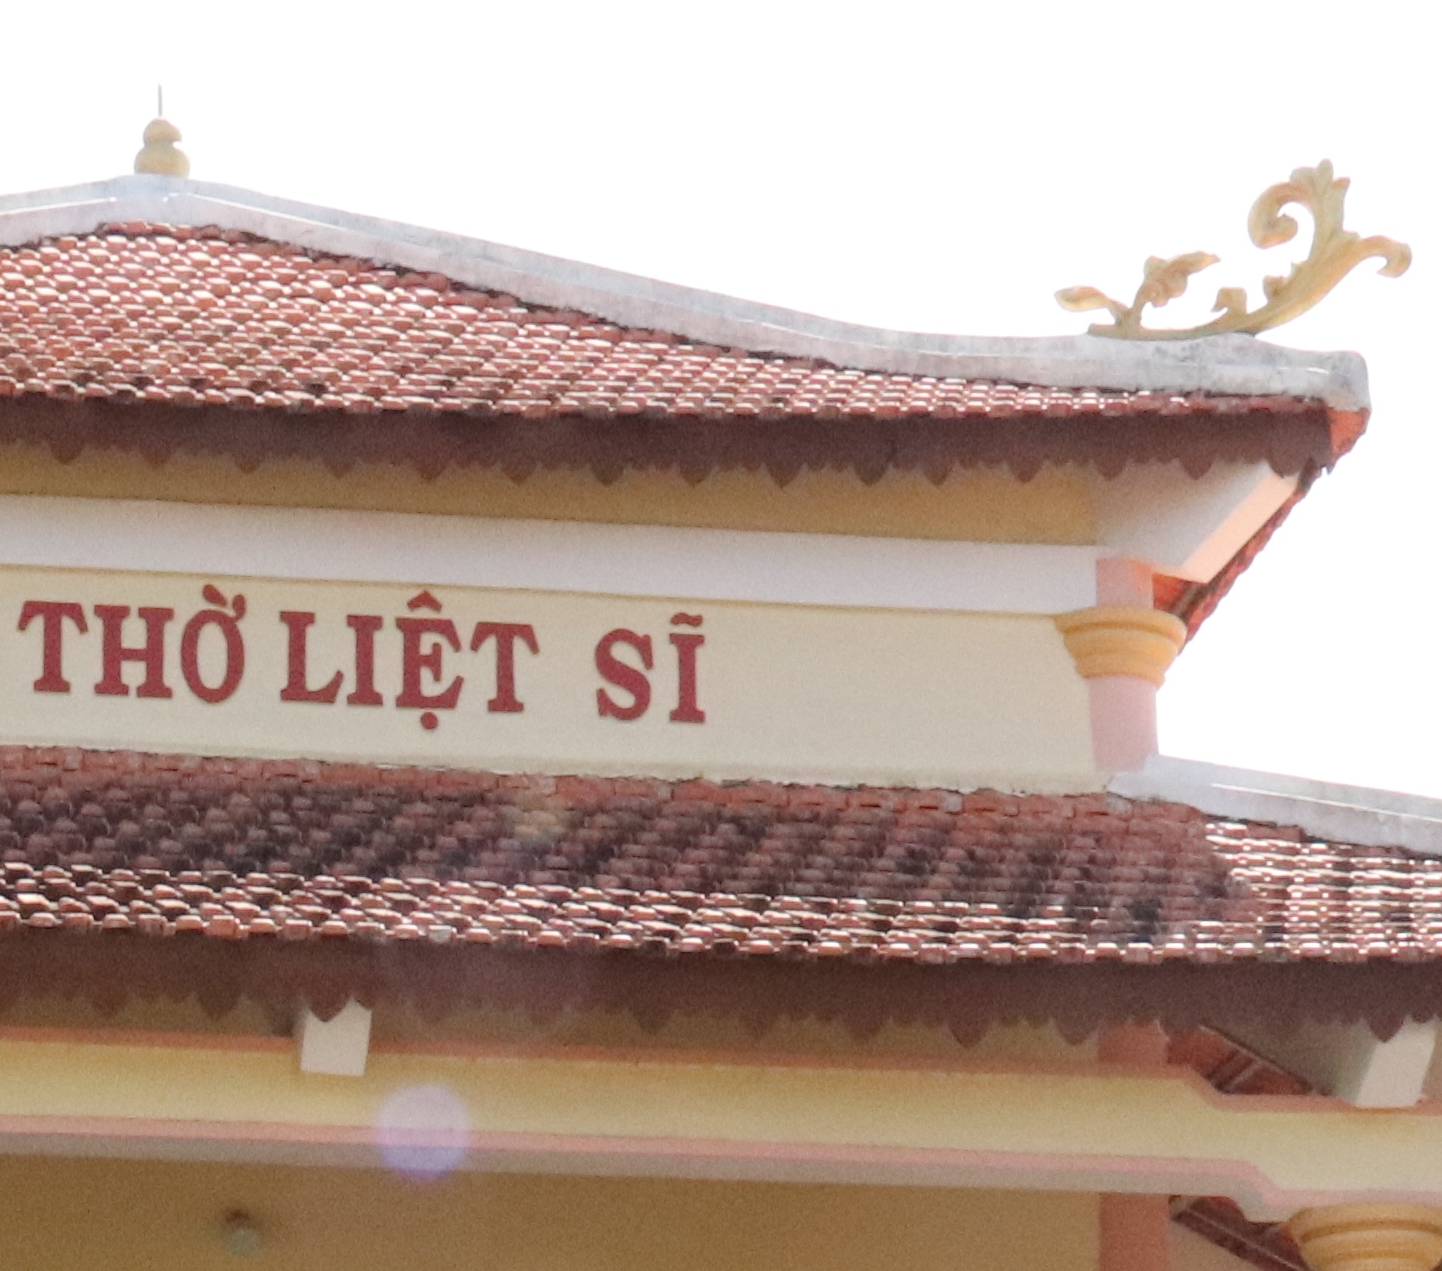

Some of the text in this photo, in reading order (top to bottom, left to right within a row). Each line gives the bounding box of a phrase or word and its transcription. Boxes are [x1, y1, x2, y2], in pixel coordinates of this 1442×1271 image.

[17, 583, 248, 704] THỜ
[278, 589, 540, 731] LIỆT
[594, 611, 708, 725] SĨ
